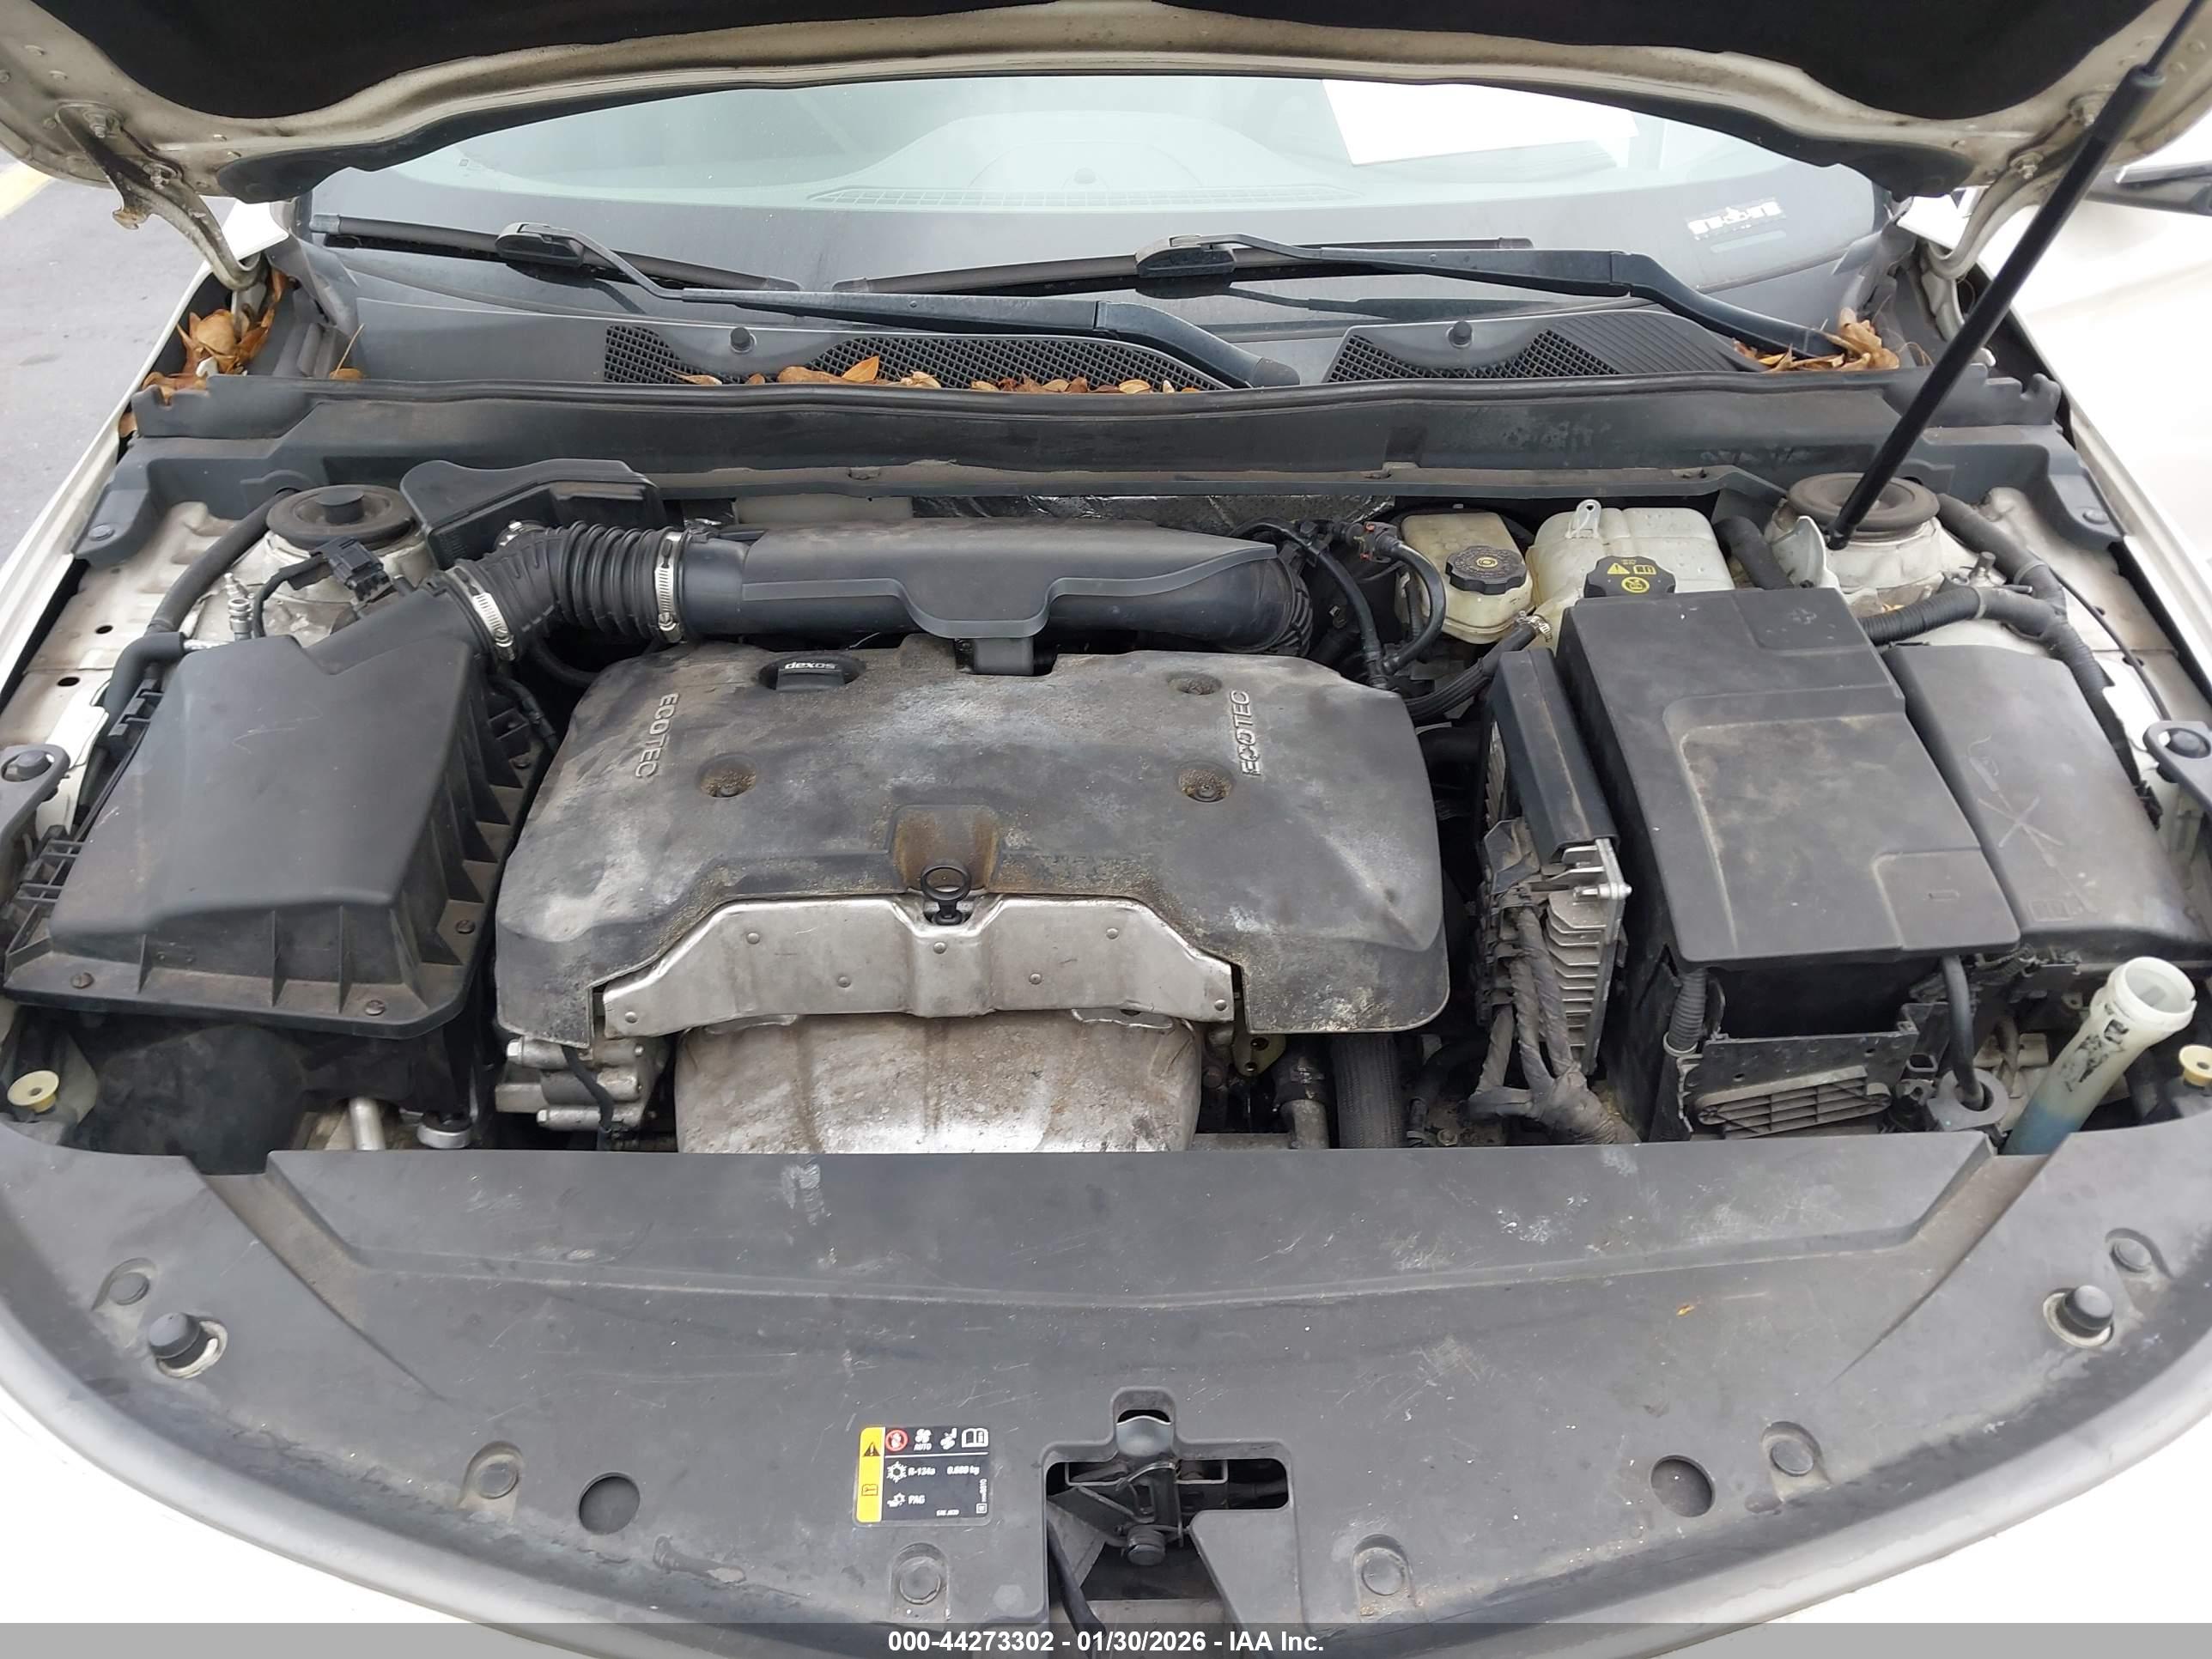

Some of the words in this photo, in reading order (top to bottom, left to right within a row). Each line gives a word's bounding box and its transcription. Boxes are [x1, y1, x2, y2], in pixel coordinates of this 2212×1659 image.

[784, 660, 838, 670] dexos
[634, 692, 680, 779] ECOTEC
[1230, 690, 1261, 776] ECOTEC
[914, 1443, 933, 1451] AUTO
[908, 1494, 926, 1505] PAG
